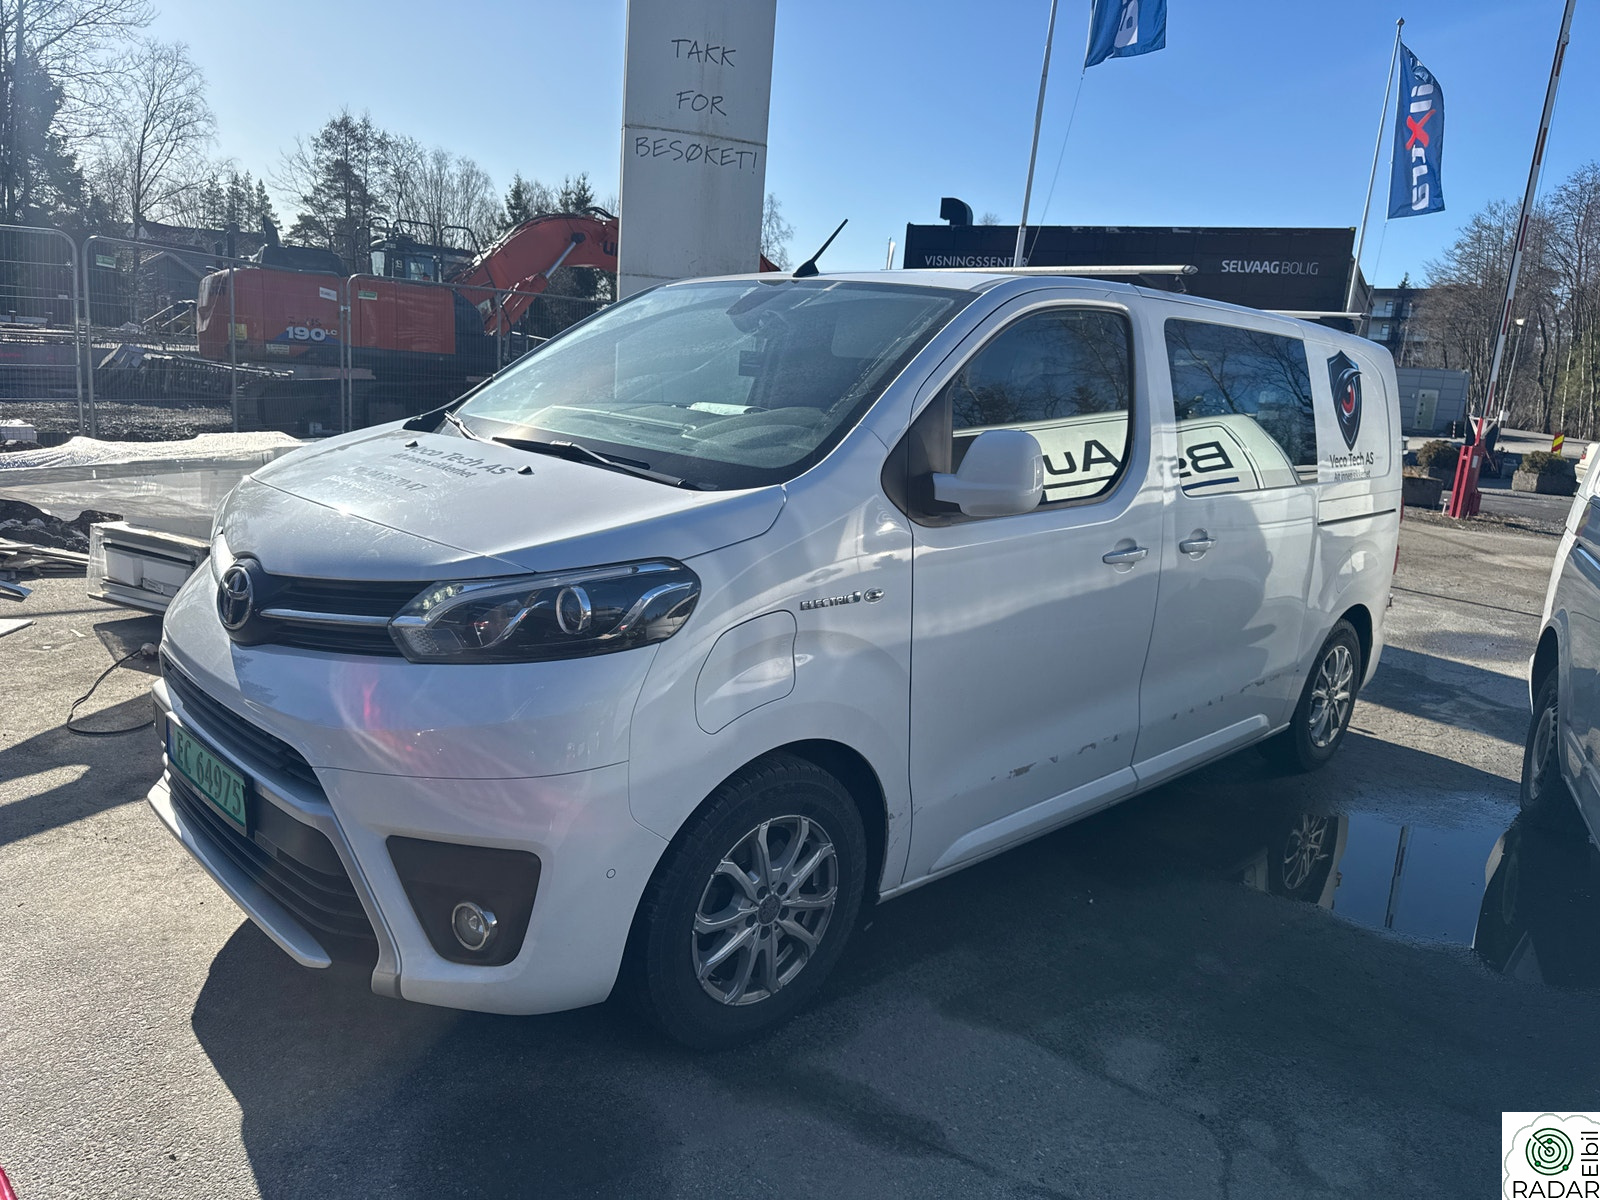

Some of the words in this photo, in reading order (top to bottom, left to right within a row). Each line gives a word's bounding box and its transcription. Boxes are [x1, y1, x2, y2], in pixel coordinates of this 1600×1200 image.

[671, 39, 737, 67] TAKK
[676, 90, 727, 116] FOR
[635, 136, 757, 175] BESØKET!
[925, 255, 1028, 268] VISNINGSSENTR
[441, 452, 485, 467] Tech
[476, 464, 515, 475] AS
[1329, 454, 1347, 468] Veco
[1348, 452, 1364, 467] Tech
[1365, 451, 1374, 466] AS
[800, 593, 855, 611] ELECTRIC
[196, 751, 242, 815] 64975
